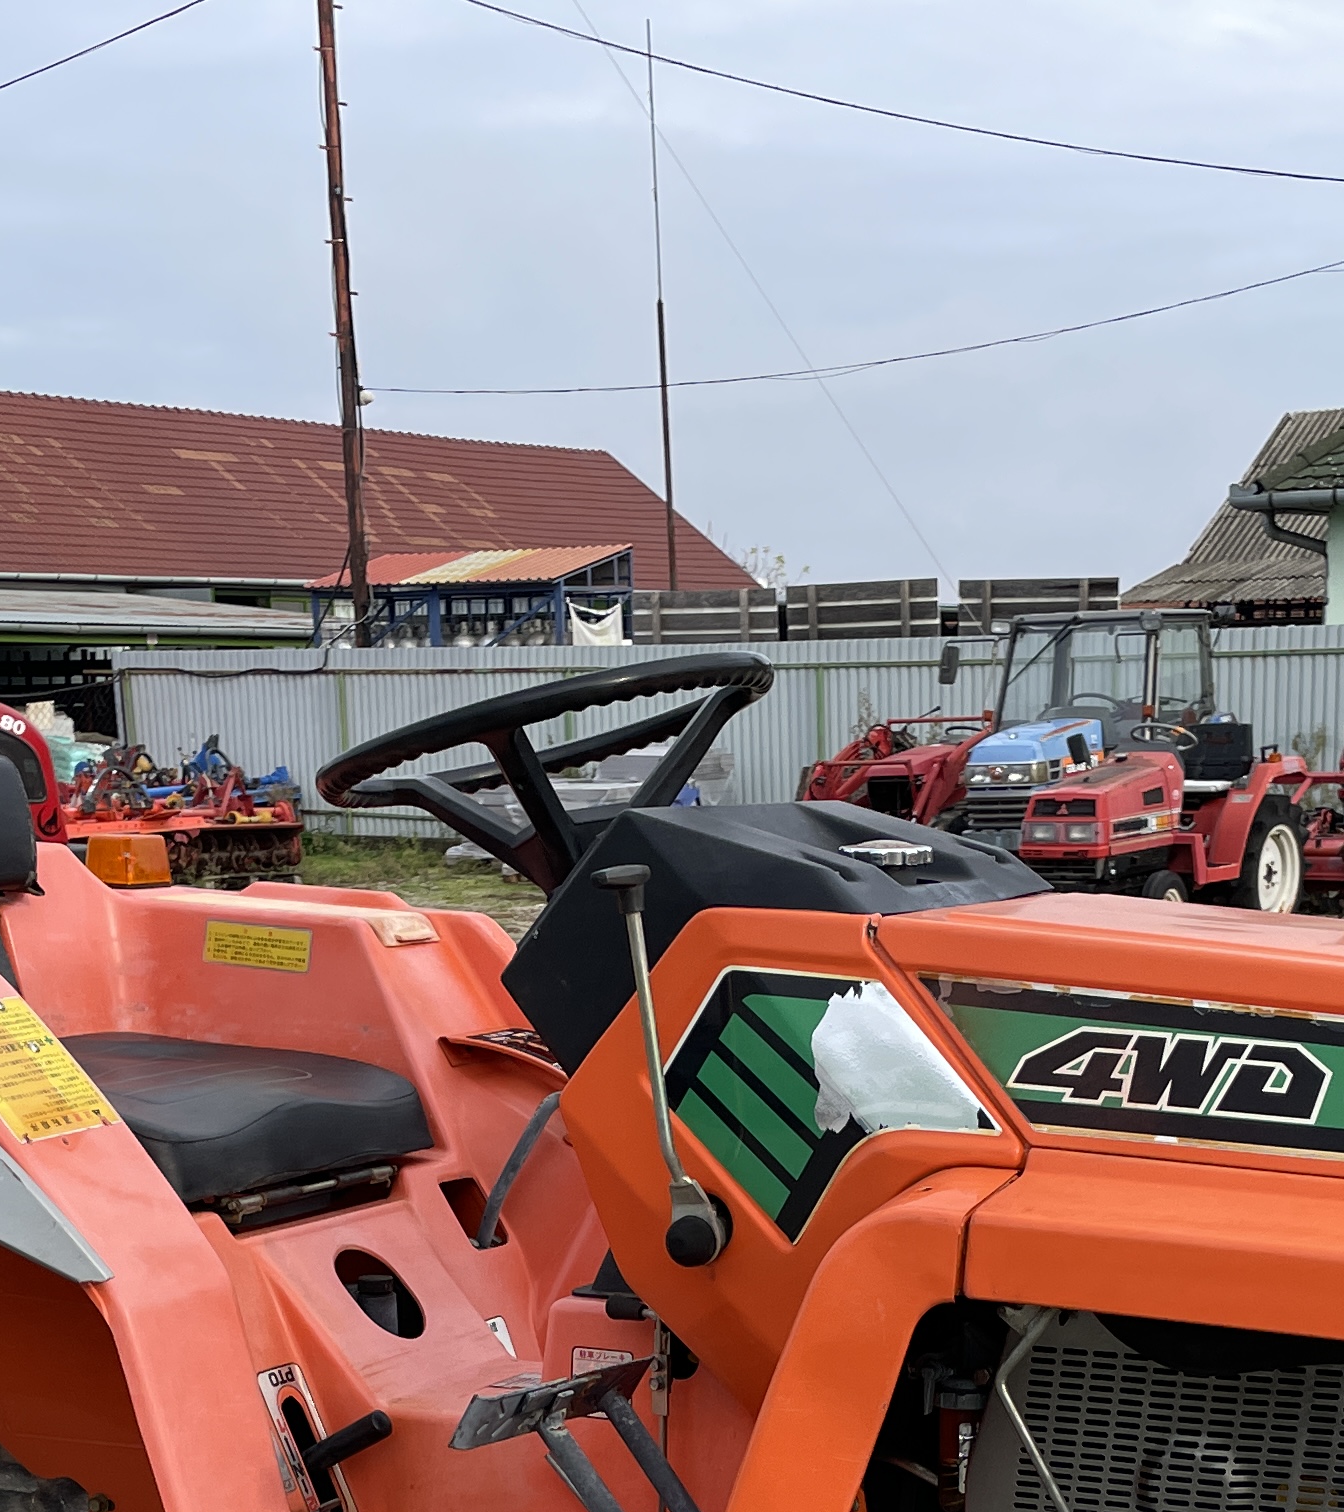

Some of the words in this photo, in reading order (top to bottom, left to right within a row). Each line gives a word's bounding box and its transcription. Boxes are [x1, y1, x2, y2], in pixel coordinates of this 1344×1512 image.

[0, 714, 26, 735] 80
[1007, 1026, 1333, 1125] 4WD
[268, 1366, 295, 1388] PTO
